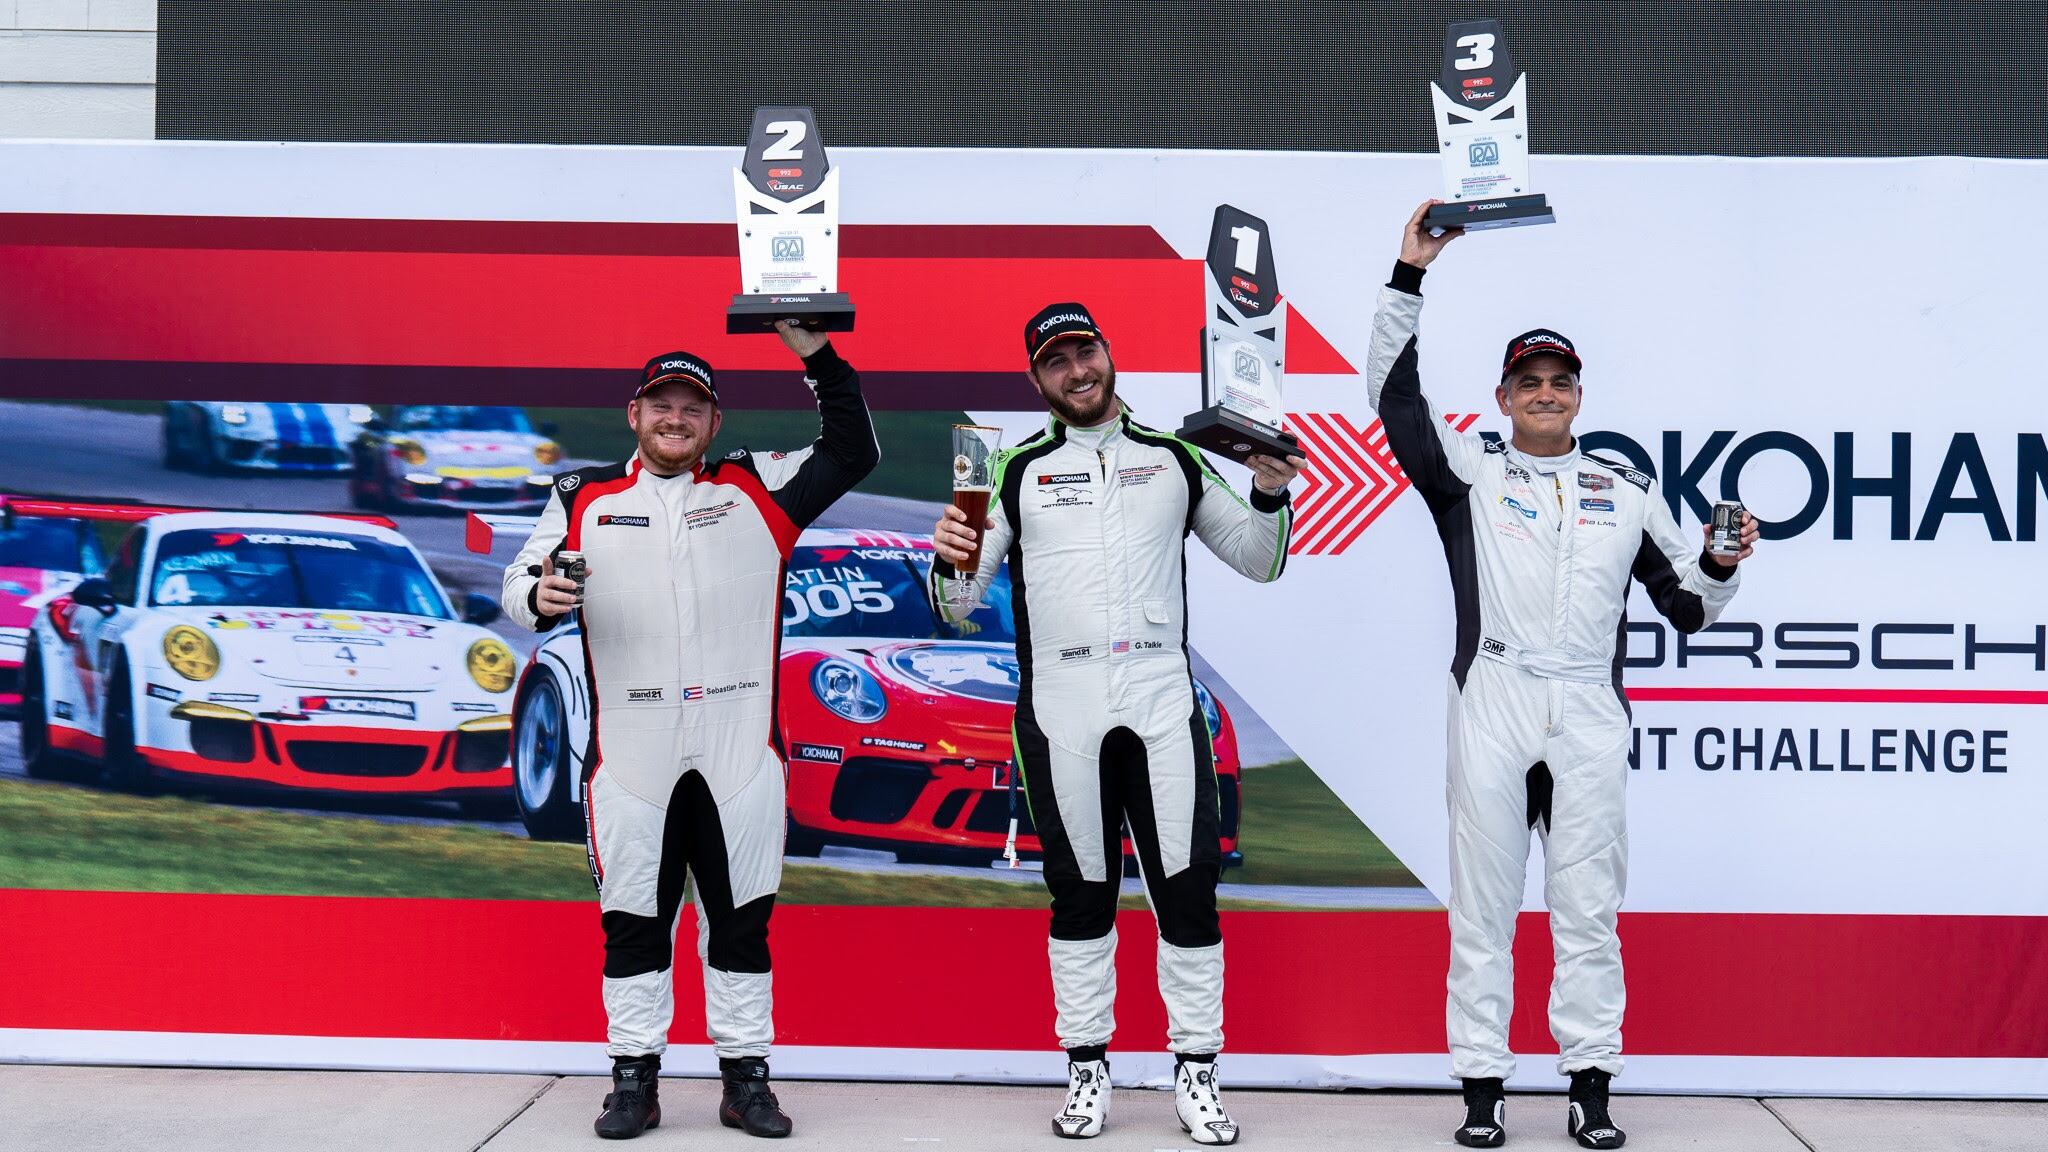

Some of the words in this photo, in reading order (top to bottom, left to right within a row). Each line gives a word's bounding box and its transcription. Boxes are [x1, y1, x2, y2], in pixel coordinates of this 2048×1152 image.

[1455, 33, 1496, 71] 3
[1468, 91, 1496, 100] USAC
[761, 120, 807, 161] 2
[1477, 203, 1508, 211] YOKOHAMA
[1230, 226, 1260, 276] 1
[1235, 294, 1260, 309] USAC
[1037, 313, 1091, 334] YOKOHAMA
[660, 359, 711, 387] YOKOHAMA
[1117, 464, 1163, 474] PORSCHE
[1051, 474, 1090, 483] YOKOHAMA
[1625, 470, 1649, 486] OMP
[684, 500, 735, 518] PORSCHE
[1041, 501, 1093, 509] MOTORSPORTS
[610, 516, 648, 526] YOKOHAMA
[686, 517, 703, 525] SPRINT
[703, 512, 729, 521] CHALLENGE
[695, 519, 720, 529] YOKOHAMA
[157, 573, 196, 605] 4
[1134, 641, 1143, 650] G.
[1482, 640, 1506, 654] OMP
[334, 646, 358, 663] 4
[706, 684, 738, 695] Sebastian
[738, 681, 760, 689] Carazo
[801, 746, 840, 761] YOKOHAMA
[1694, 727, 2008, 774] CHALLENGE
